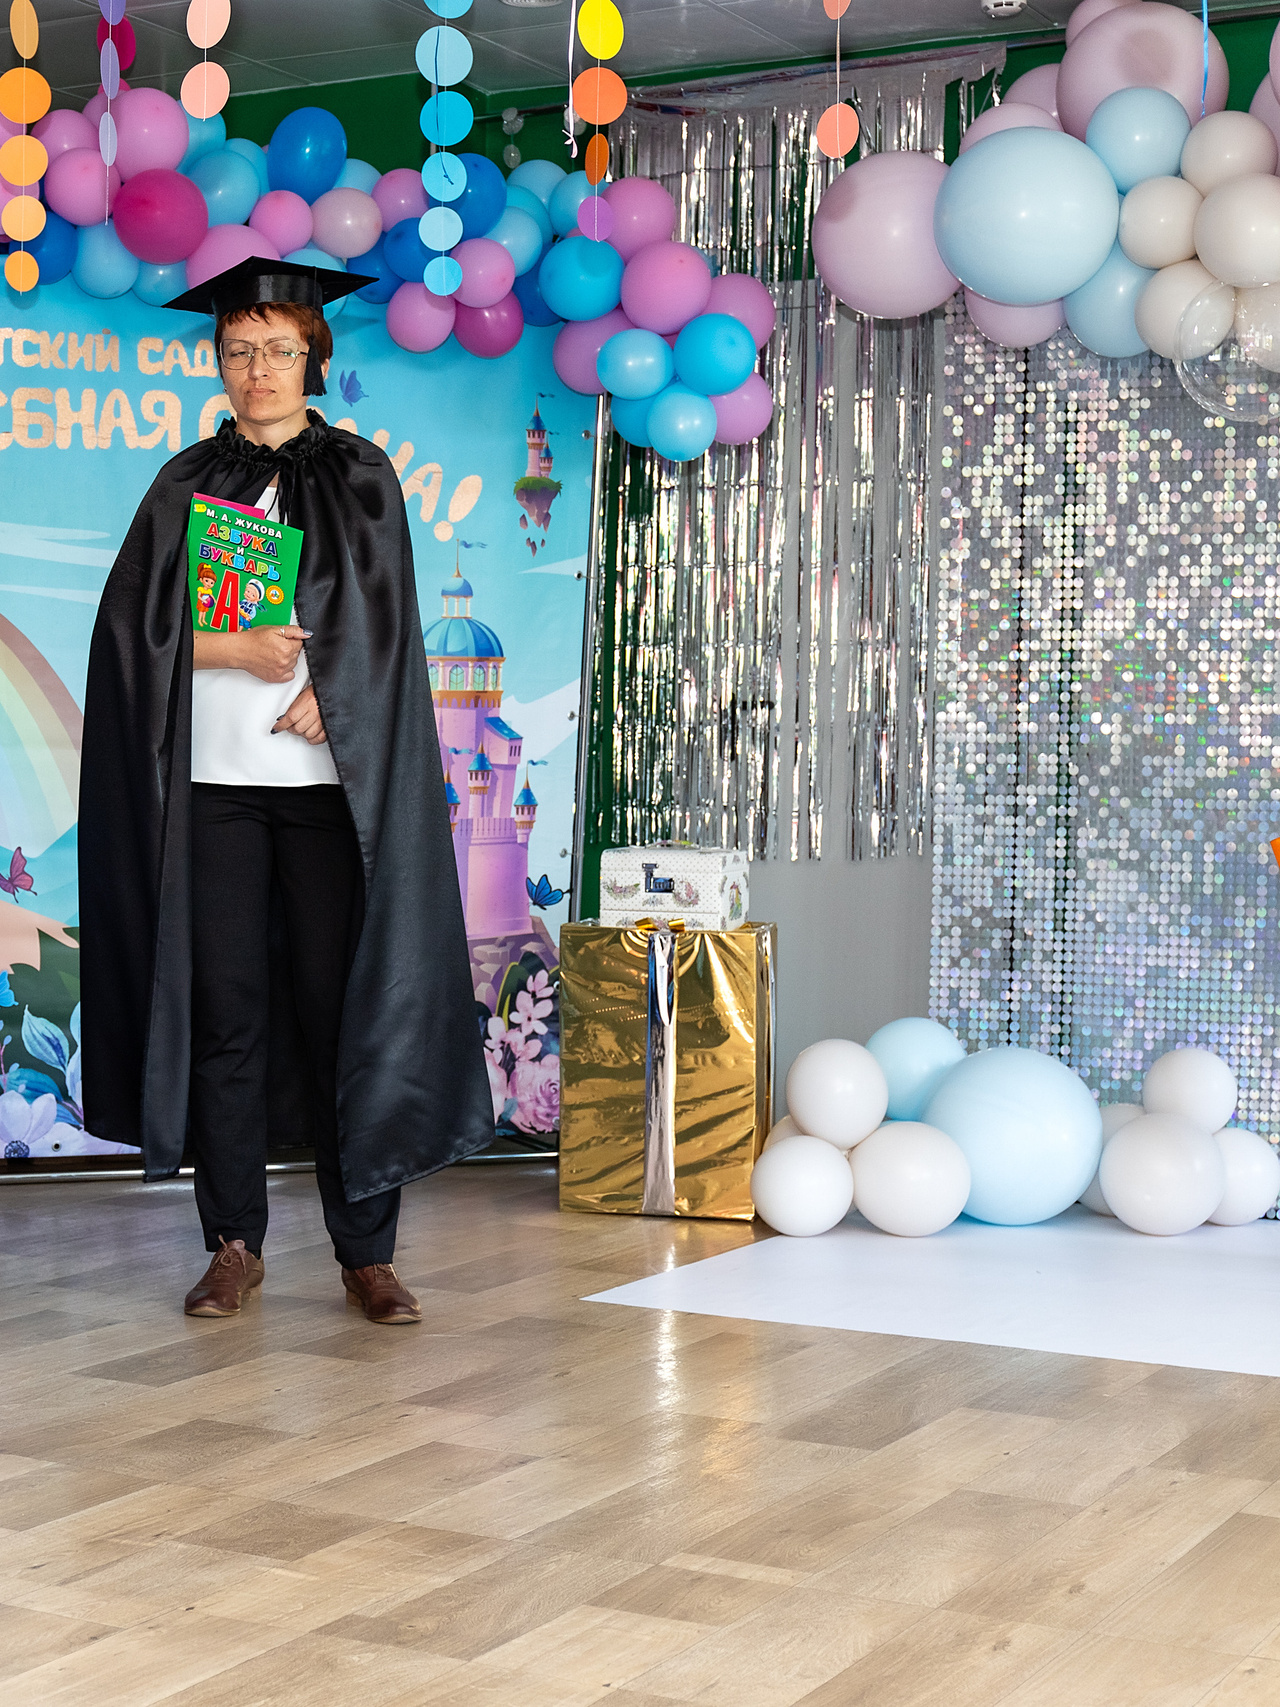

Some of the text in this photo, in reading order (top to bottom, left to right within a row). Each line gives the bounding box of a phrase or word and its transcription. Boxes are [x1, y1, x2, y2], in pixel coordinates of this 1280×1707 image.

[137, 337, 218, 378] САД
[206, 508, 218, 519] М.
[221, 513, 232, 524] А.
[234, 517, 283, 540] ЖУКОВА
[206, 522, 278, 557] АЗБУКА
[199, 543, 281, 581] БУКВАРЬ
[210, 569, 240, 632] А
